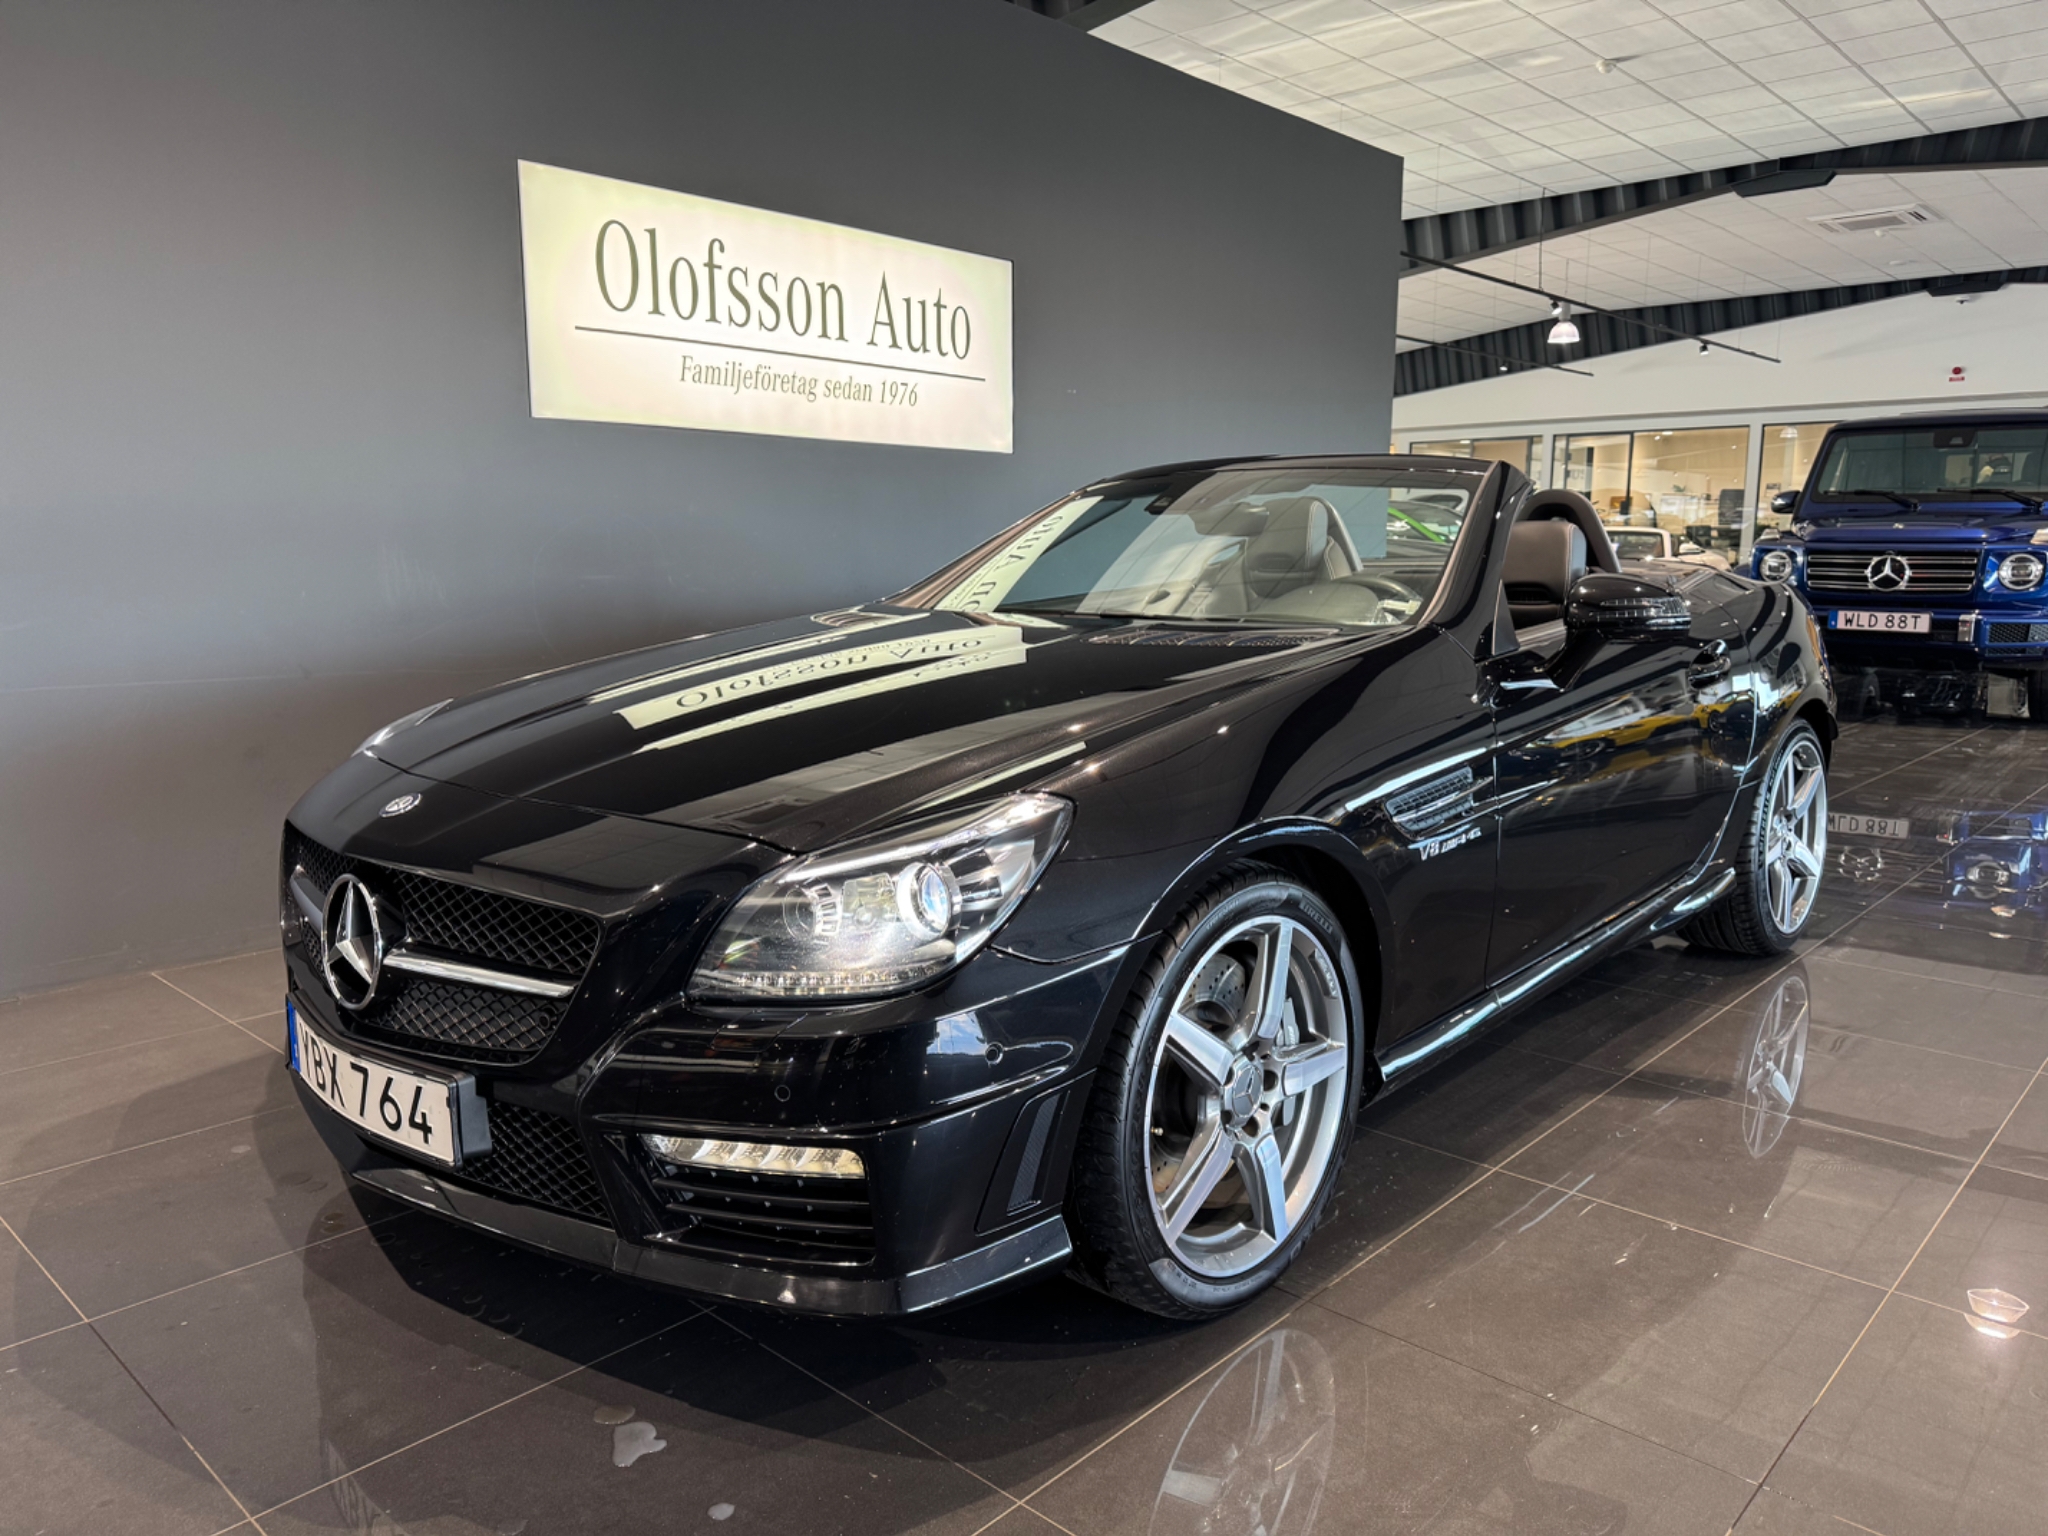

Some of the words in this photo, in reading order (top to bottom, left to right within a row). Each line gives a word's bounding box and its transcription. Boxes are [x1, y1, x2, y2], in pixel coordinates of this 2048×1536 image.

[595, 219, 849, 342] Olofsson
[866, 270, 971, 360] Auto
[680, 355, 818, 403] Familjeföretag
[823, 376, 873, 403] sedan
[880, 380, 919, 407] 1976
[1844, 612, 1878, 628] WLD
[1885, 614, 1921, 630] 88T
[350, 1060, 433, 1145] 764
